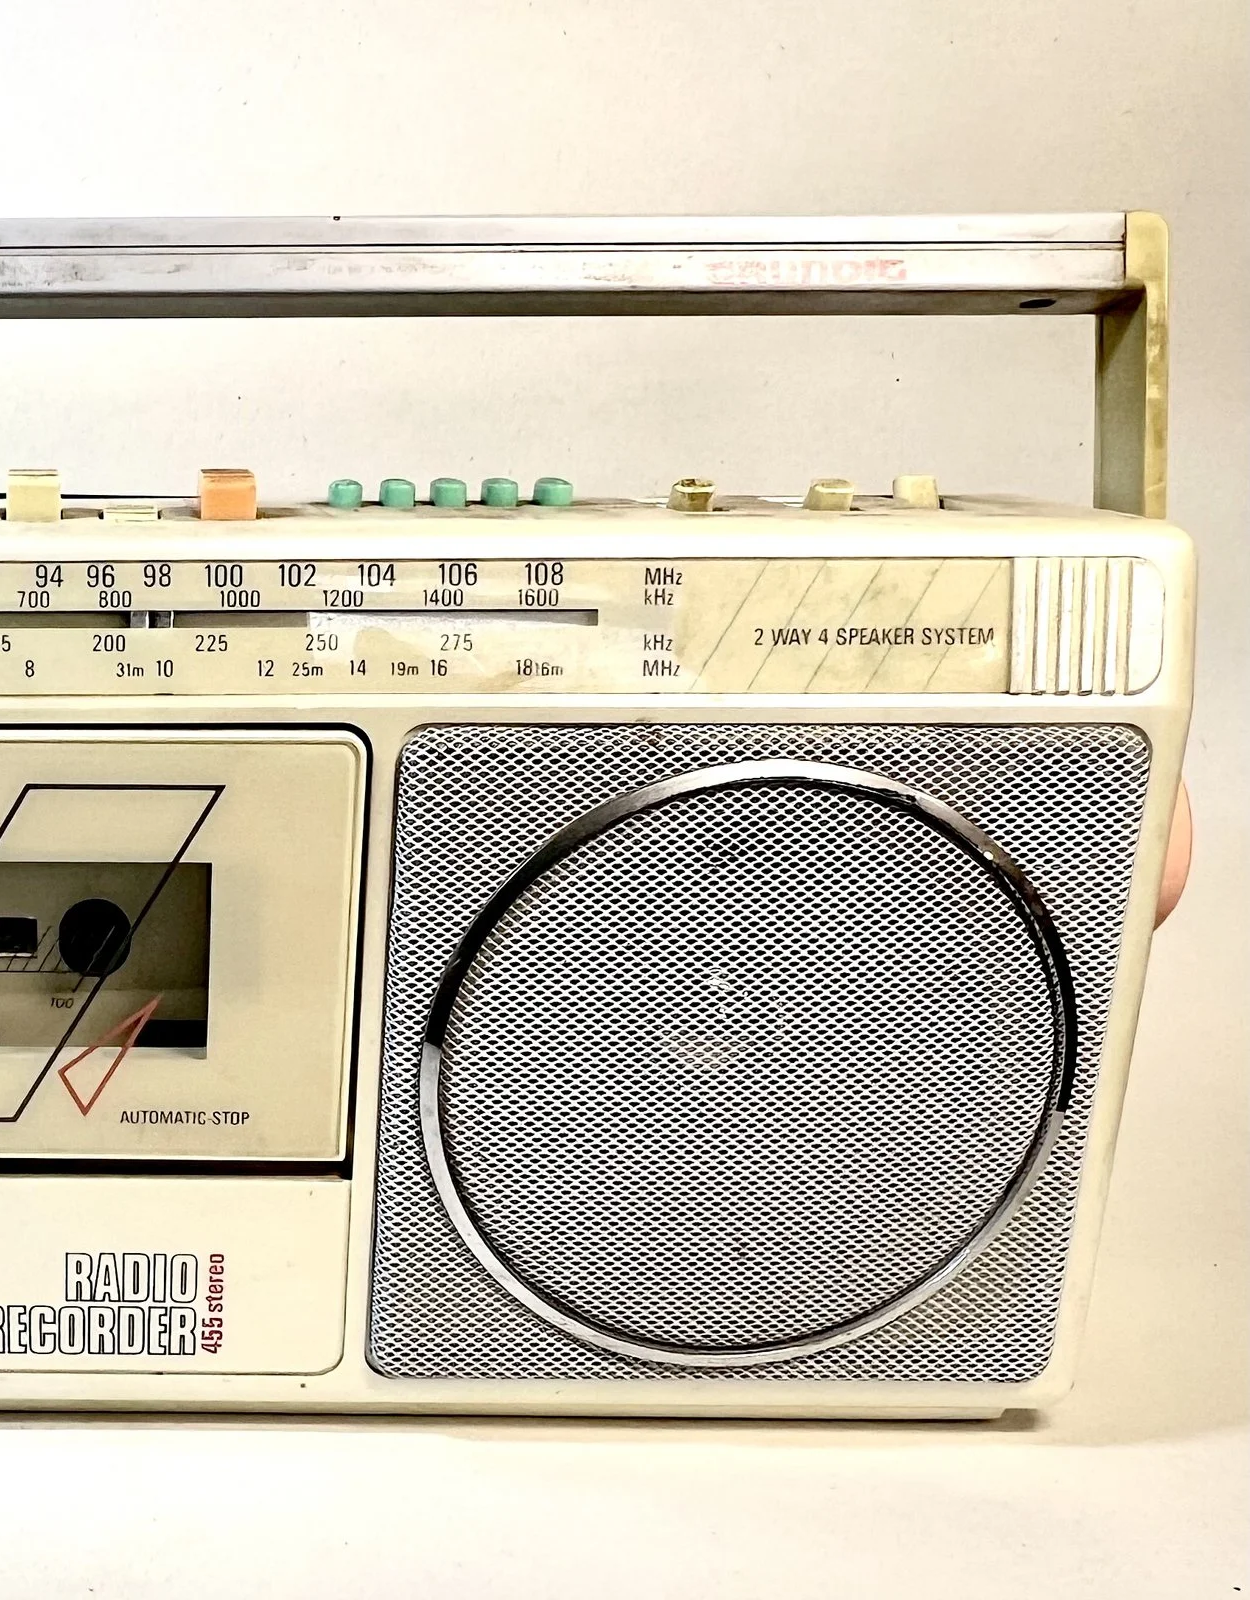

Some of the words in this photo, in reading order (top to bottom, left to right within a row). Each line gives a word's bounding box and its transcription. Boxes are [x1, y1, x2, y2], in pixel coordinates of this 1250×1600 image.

[35, 565, 64, 588] 94
[87, 565, 115, 588] 96
[144, 564, 171, 587] 98
[205, 565, 243, 587] 100
[279, 564, 317, 587] 102
[358, 563, 396, 586] 104
[439, 563, 478, 586] 106
[526, 562, 564, 586] 108
[645, 567, 683, 586] MHz
[17, 591, 50, 608] 700
[99, 591, 132, 608] 800
[221, 591, 261, 608] 1000
[324, 590, 364, 607] 1200
[423, 589, 464, 606] 1400
[519, 589, 559, 606] 1600
[644, 588, 674, 606] kHz
[93, 635, 126, 652] 200
[196, 635, 228, 652] 225
[306, 635, 338, 651] 250
[441, 634, 473, 651] 275
[644, 634, 673, 652] kHz
[754, 628, 763, 646] 2
[772, 628, 810, 646] WAY
[819, 628, 828, 646] 4
[837, 628, 914, 646] SPEAKER
[922, 628, 994, 646] SYSTEM
[25, 660, 35, 677] 8
[116, 663, 144, 677] 31m
[156, 660, 173, 677] 10
[258, 660, 274, 677] 12
[292, 663, 323, 676] 25m
[350, 660, 366, 676] 14
[391, 663, 419, 676] 19m
[431, 660, 447, 676] 16
[643, 661, 680, 677] MHz
[51, 997, 74, 1009] 100
[66, 1252, 198, 1304] RADIO
[206, 1253, 225, 1312] stereo
[201, 1317, 223, 1354] 455
